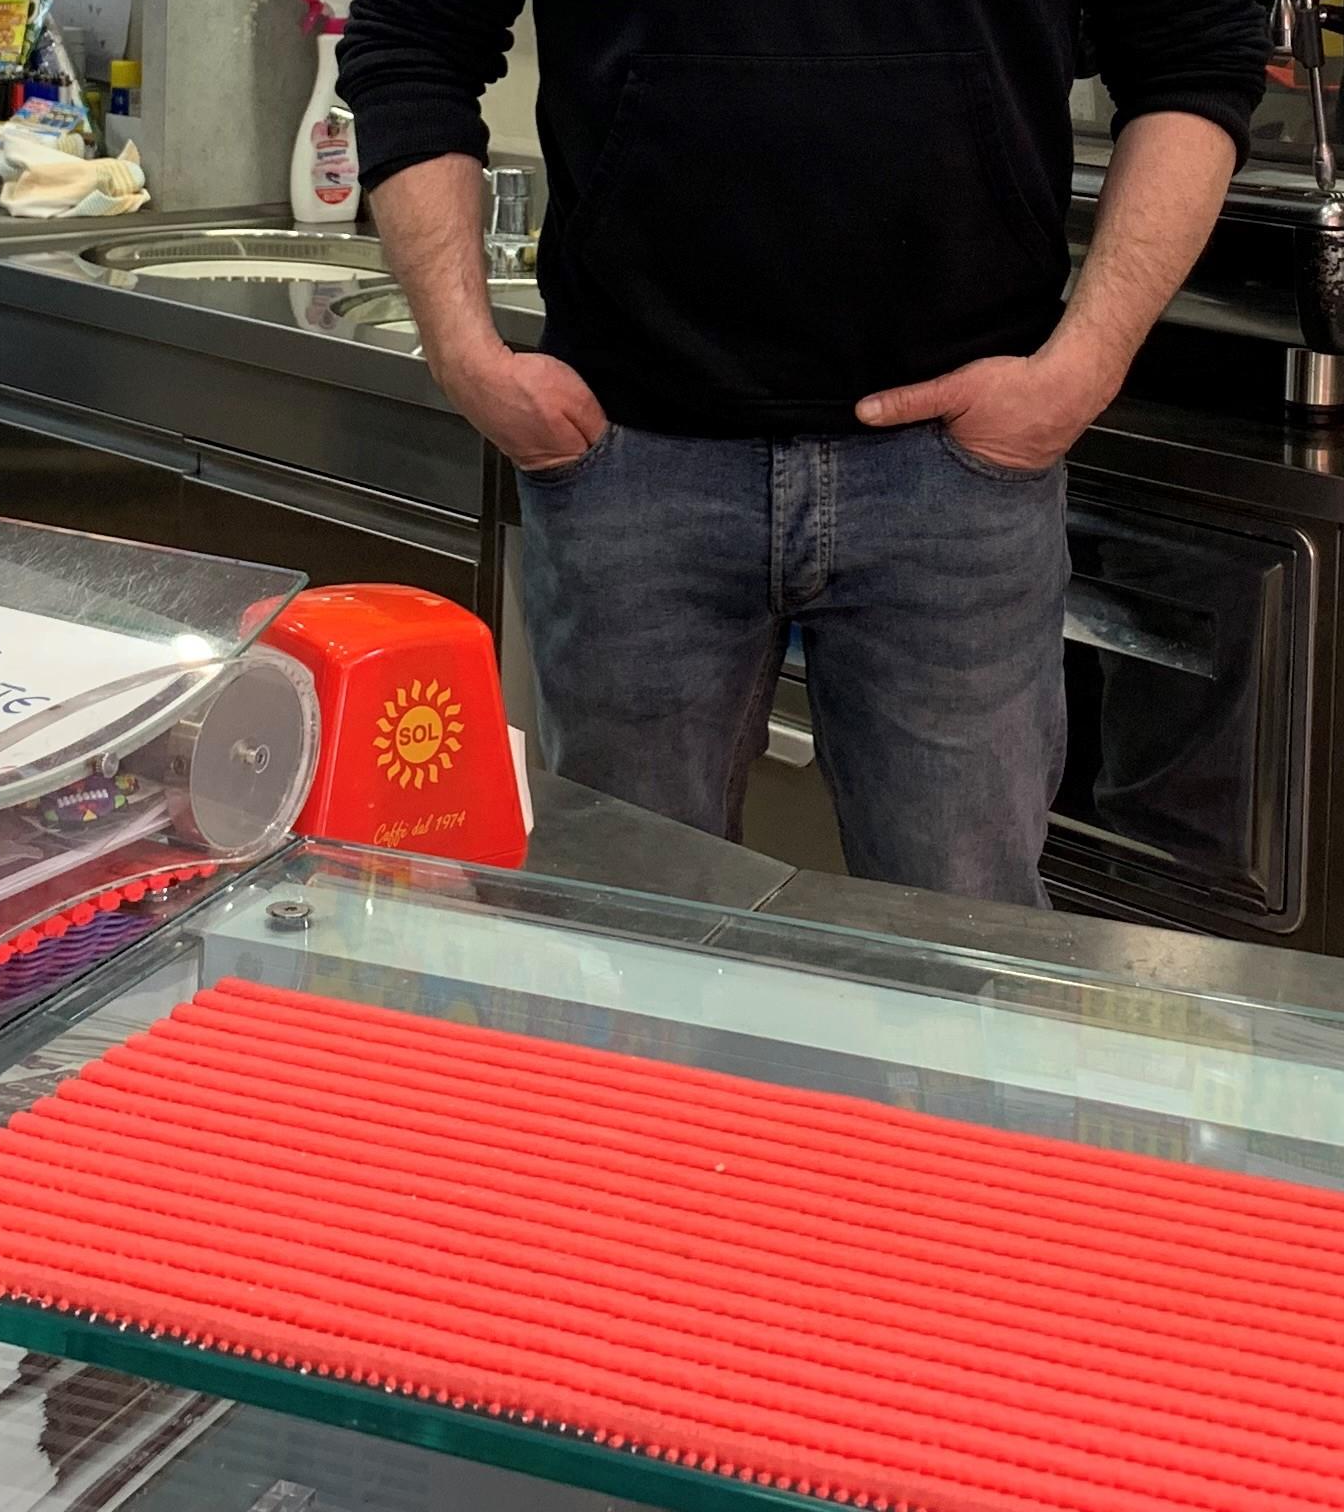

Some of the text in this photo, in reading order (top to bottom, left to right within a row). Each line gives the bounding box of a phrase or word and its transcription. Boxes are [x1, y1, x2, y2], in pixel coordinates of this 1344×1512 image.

[399, 723, 439, 746] SOL
[374, 810, 466, 849] Caffè dal 1974
